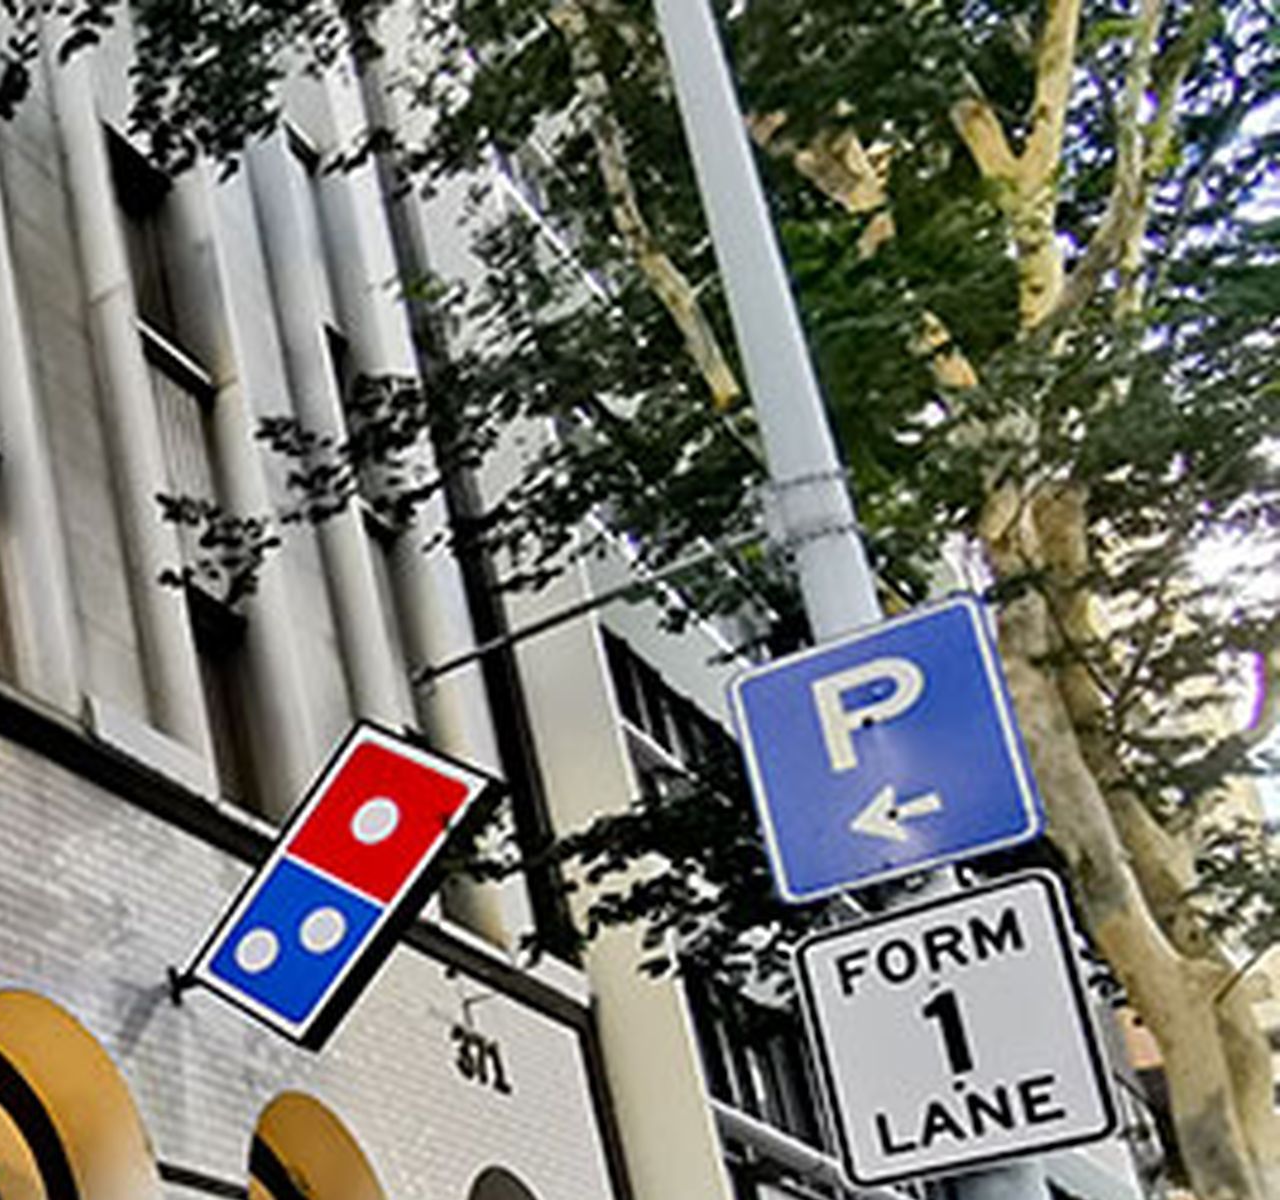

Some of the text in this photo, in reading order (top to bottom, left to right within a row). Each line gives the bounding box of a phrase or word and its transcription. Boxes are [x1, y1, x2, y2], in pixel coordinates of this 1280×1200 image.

[811, 657, 925, 772] P
[834, 907, 1025, 996] FORM
[450, 1024, 513, 1096] 371
[922, 990, 975, 1076] 1
[875, 1075, 1066, 1157] LANE
